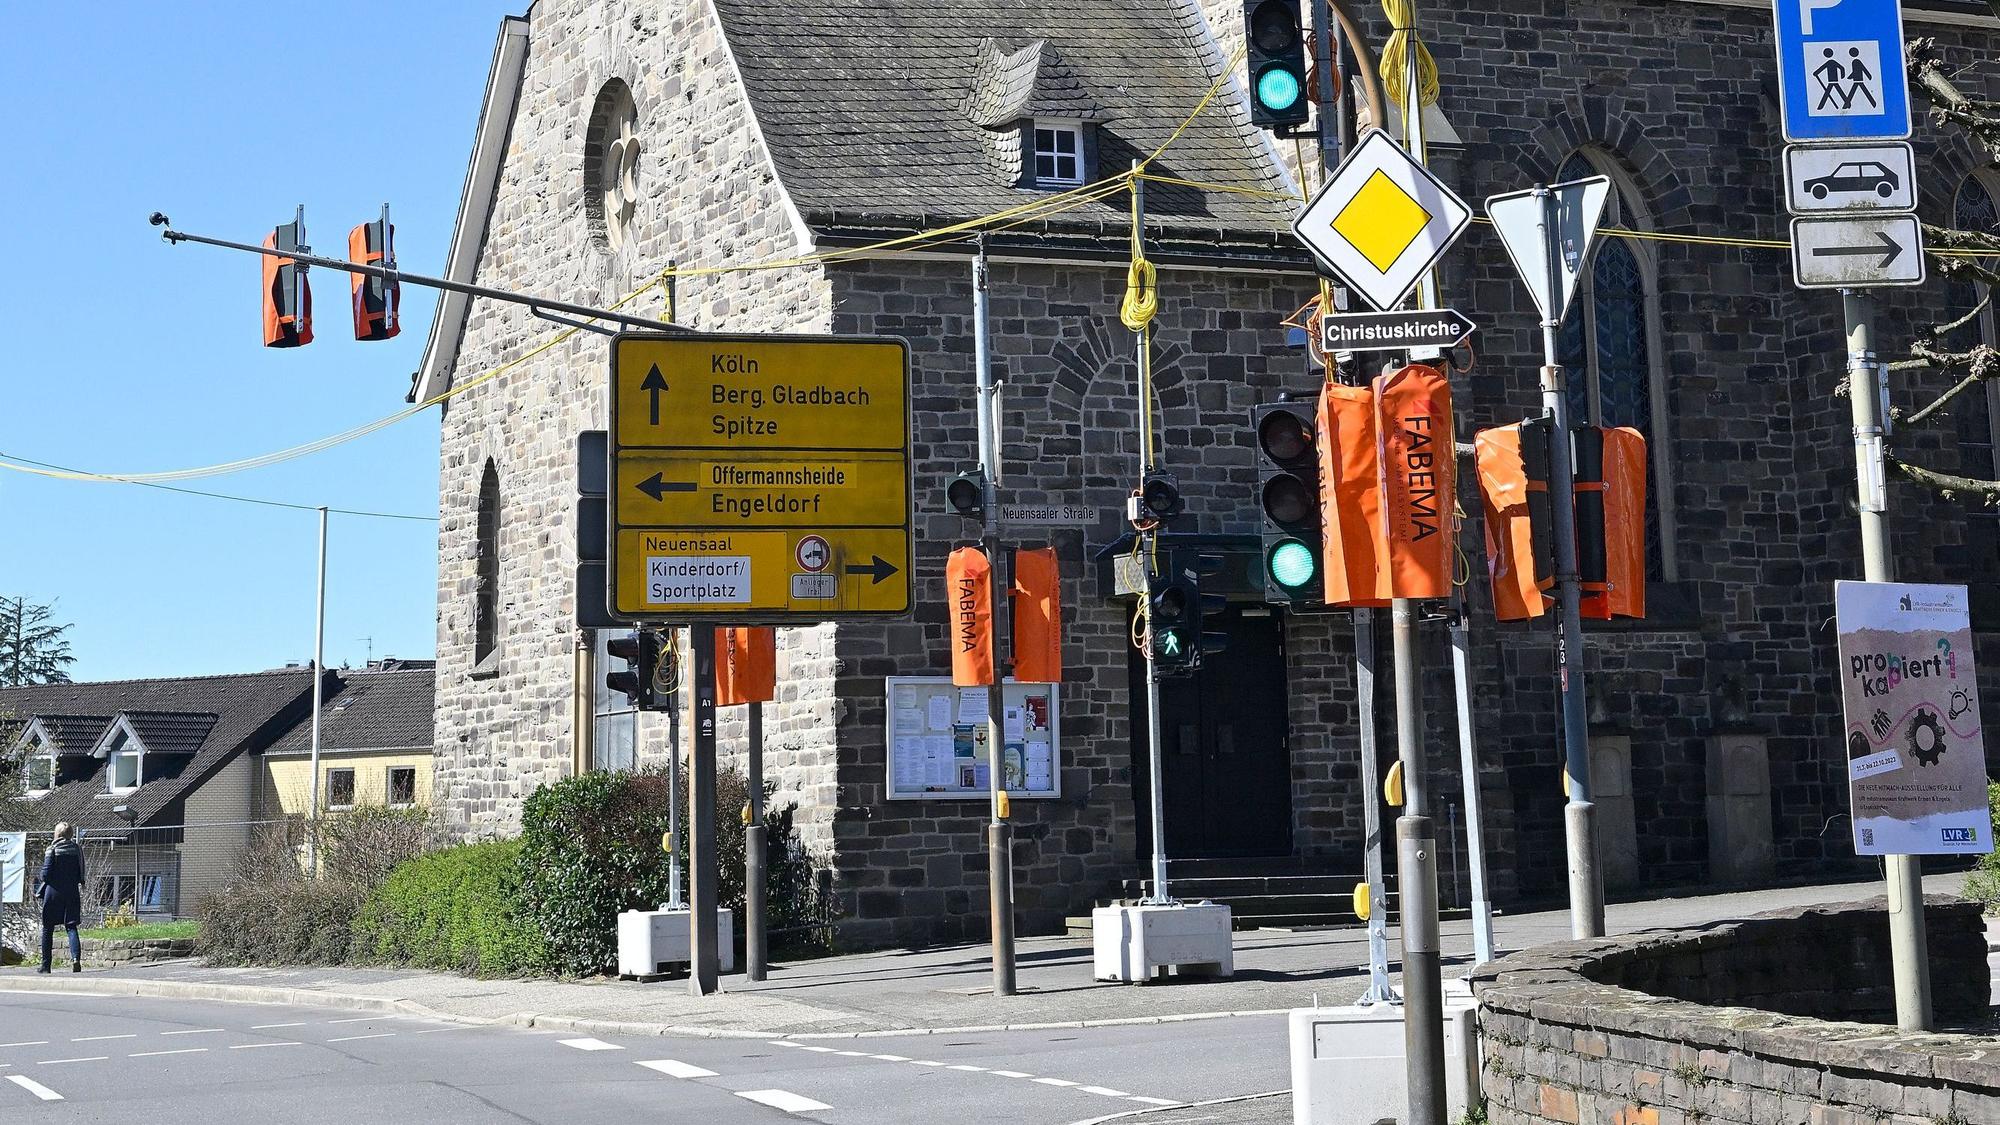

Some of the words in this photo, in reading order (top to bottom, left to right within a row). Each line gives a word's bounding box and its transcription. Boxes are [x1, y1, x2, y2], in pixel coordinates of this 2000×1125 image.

[1327, 320, 1461, 342] Christuskirche
[711, 354, 759, 374] Köln
[711, 384, 766, 409] Berg.
[772, 385, 870, 406] Gladbach
[712, 415, 778, 439] Spitze
[712, 466, 845, 485] Offermannsheide
[1404, 416, 1438, 542] FABEMA
[711, 494, 820, 518] Engeldorf
[1003, 507, 1059, 520] Neuensaaler
[1063, 506, 1094, 520] Straße
[646, 537, 732, 551] Neuensaal
[651, 561, 746, 577] Kinderdorf/
[652, 583, 736, 602] Sportplatz
[959, 578, 977, 653] FABEMA
[1943, 830, 1963, 840] LVR
